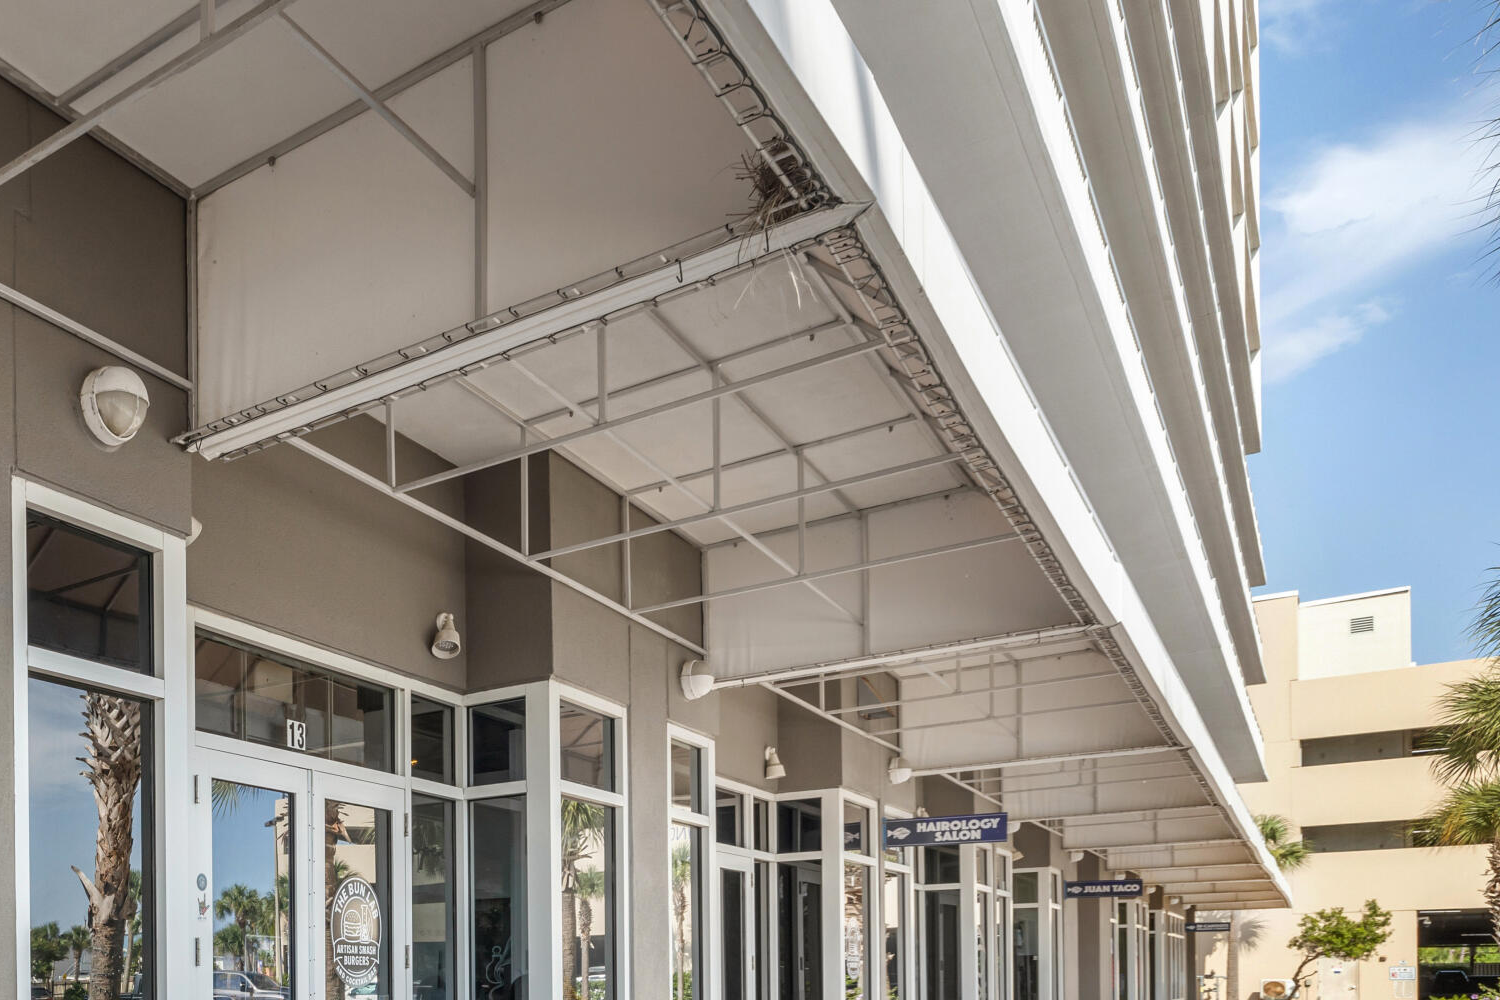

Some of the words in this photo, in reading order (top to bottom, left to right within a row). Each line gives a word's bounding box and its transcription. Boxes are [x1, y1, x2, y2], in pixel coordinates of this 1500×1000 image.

[289, 721, 304, 749] 13
[916, 817, 1000, 833] HAIROLOGY
[934, 829, 981, 842] SALON
[1083, 885, 1110, 893] JUAN
[1111, 884, 1140, 893] TACO
[334, 888, 349, 914] THE
[348, 882, 366, 897] BUN
[366, 892, 379, 920] LAB
[336, 944, 359, 954] ARTISAN
[359, 945, 377, 955] SMASH
[343, 956, 370, 966] BURGERS
